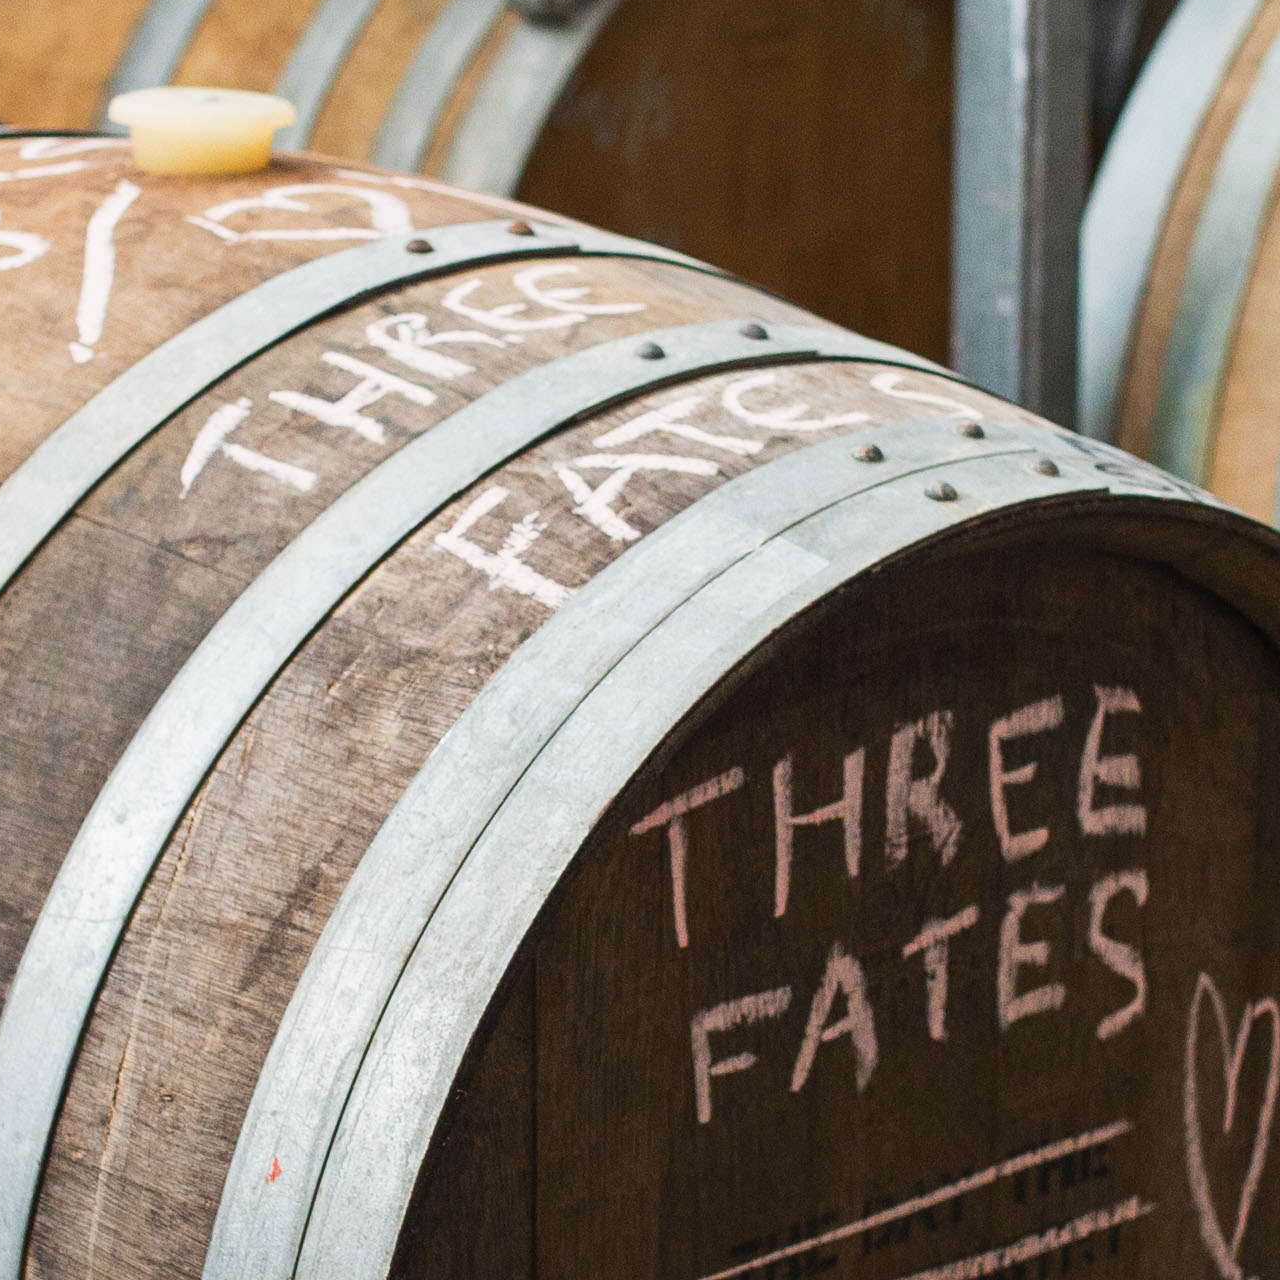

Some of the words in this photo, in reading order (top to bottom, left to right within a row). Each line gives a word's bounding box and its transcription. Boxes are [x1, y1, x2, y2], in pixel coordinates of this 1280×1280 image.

[180, 263, 644, 498] THREE
[433, 369, 982, 607] FATES
[629, 684, 1147, 948] THREE
[690, 869, 1148, 1124] FATES
